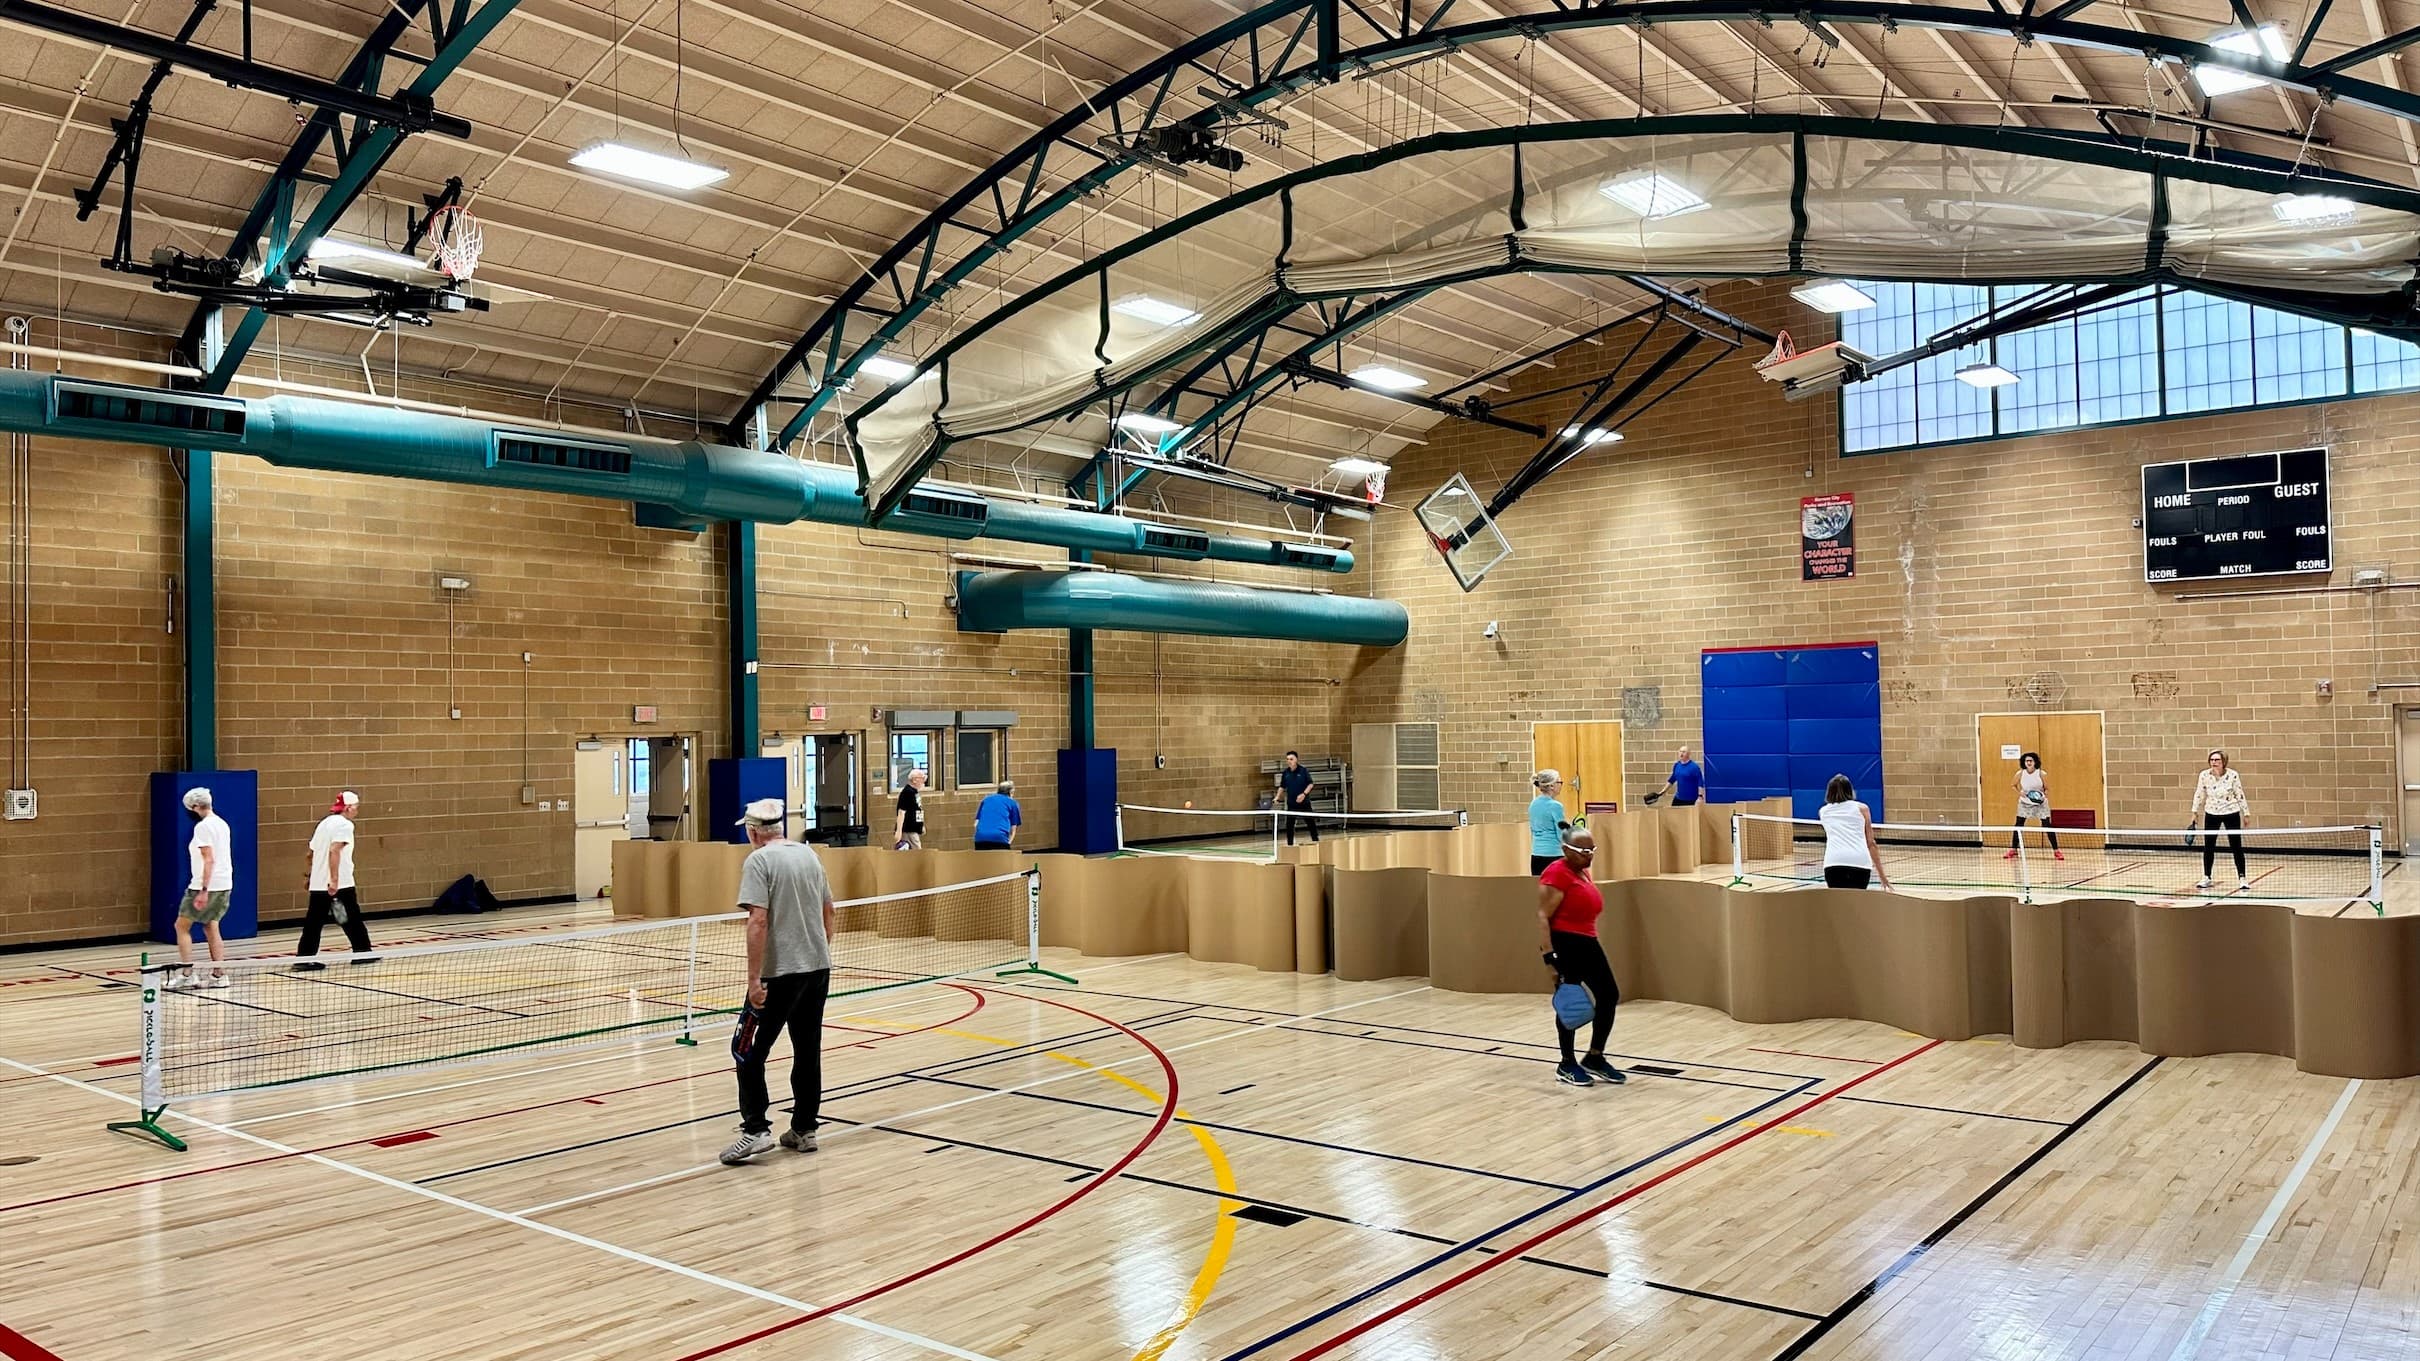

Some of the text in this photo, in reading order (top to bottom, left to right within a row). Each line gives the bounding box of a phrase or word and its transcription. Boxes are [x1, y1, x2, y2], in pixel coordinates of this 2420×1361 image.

[2274, 482, 2319, 498] GUEST
[2154, 493, 2192, 508] HOME
[2217, 494, 2250, 506] PERIOD
[2204, 530, 2267, 543] PLAYER FOUL
[2295, 525, 2327, 537] FOULS
[1817, 540, 1838, 548] YOUR
[2149, 536, 2177, 547] FOULS
[1804, 547, 1852, 558] CHARACTER
[1812, 564, 1846, 574] WORLD
[2220, 564, 2252, 575] MATCH
[2295, 559, 2327, 570] SCORE
[2149, 569, 2177, 579] SCORE
